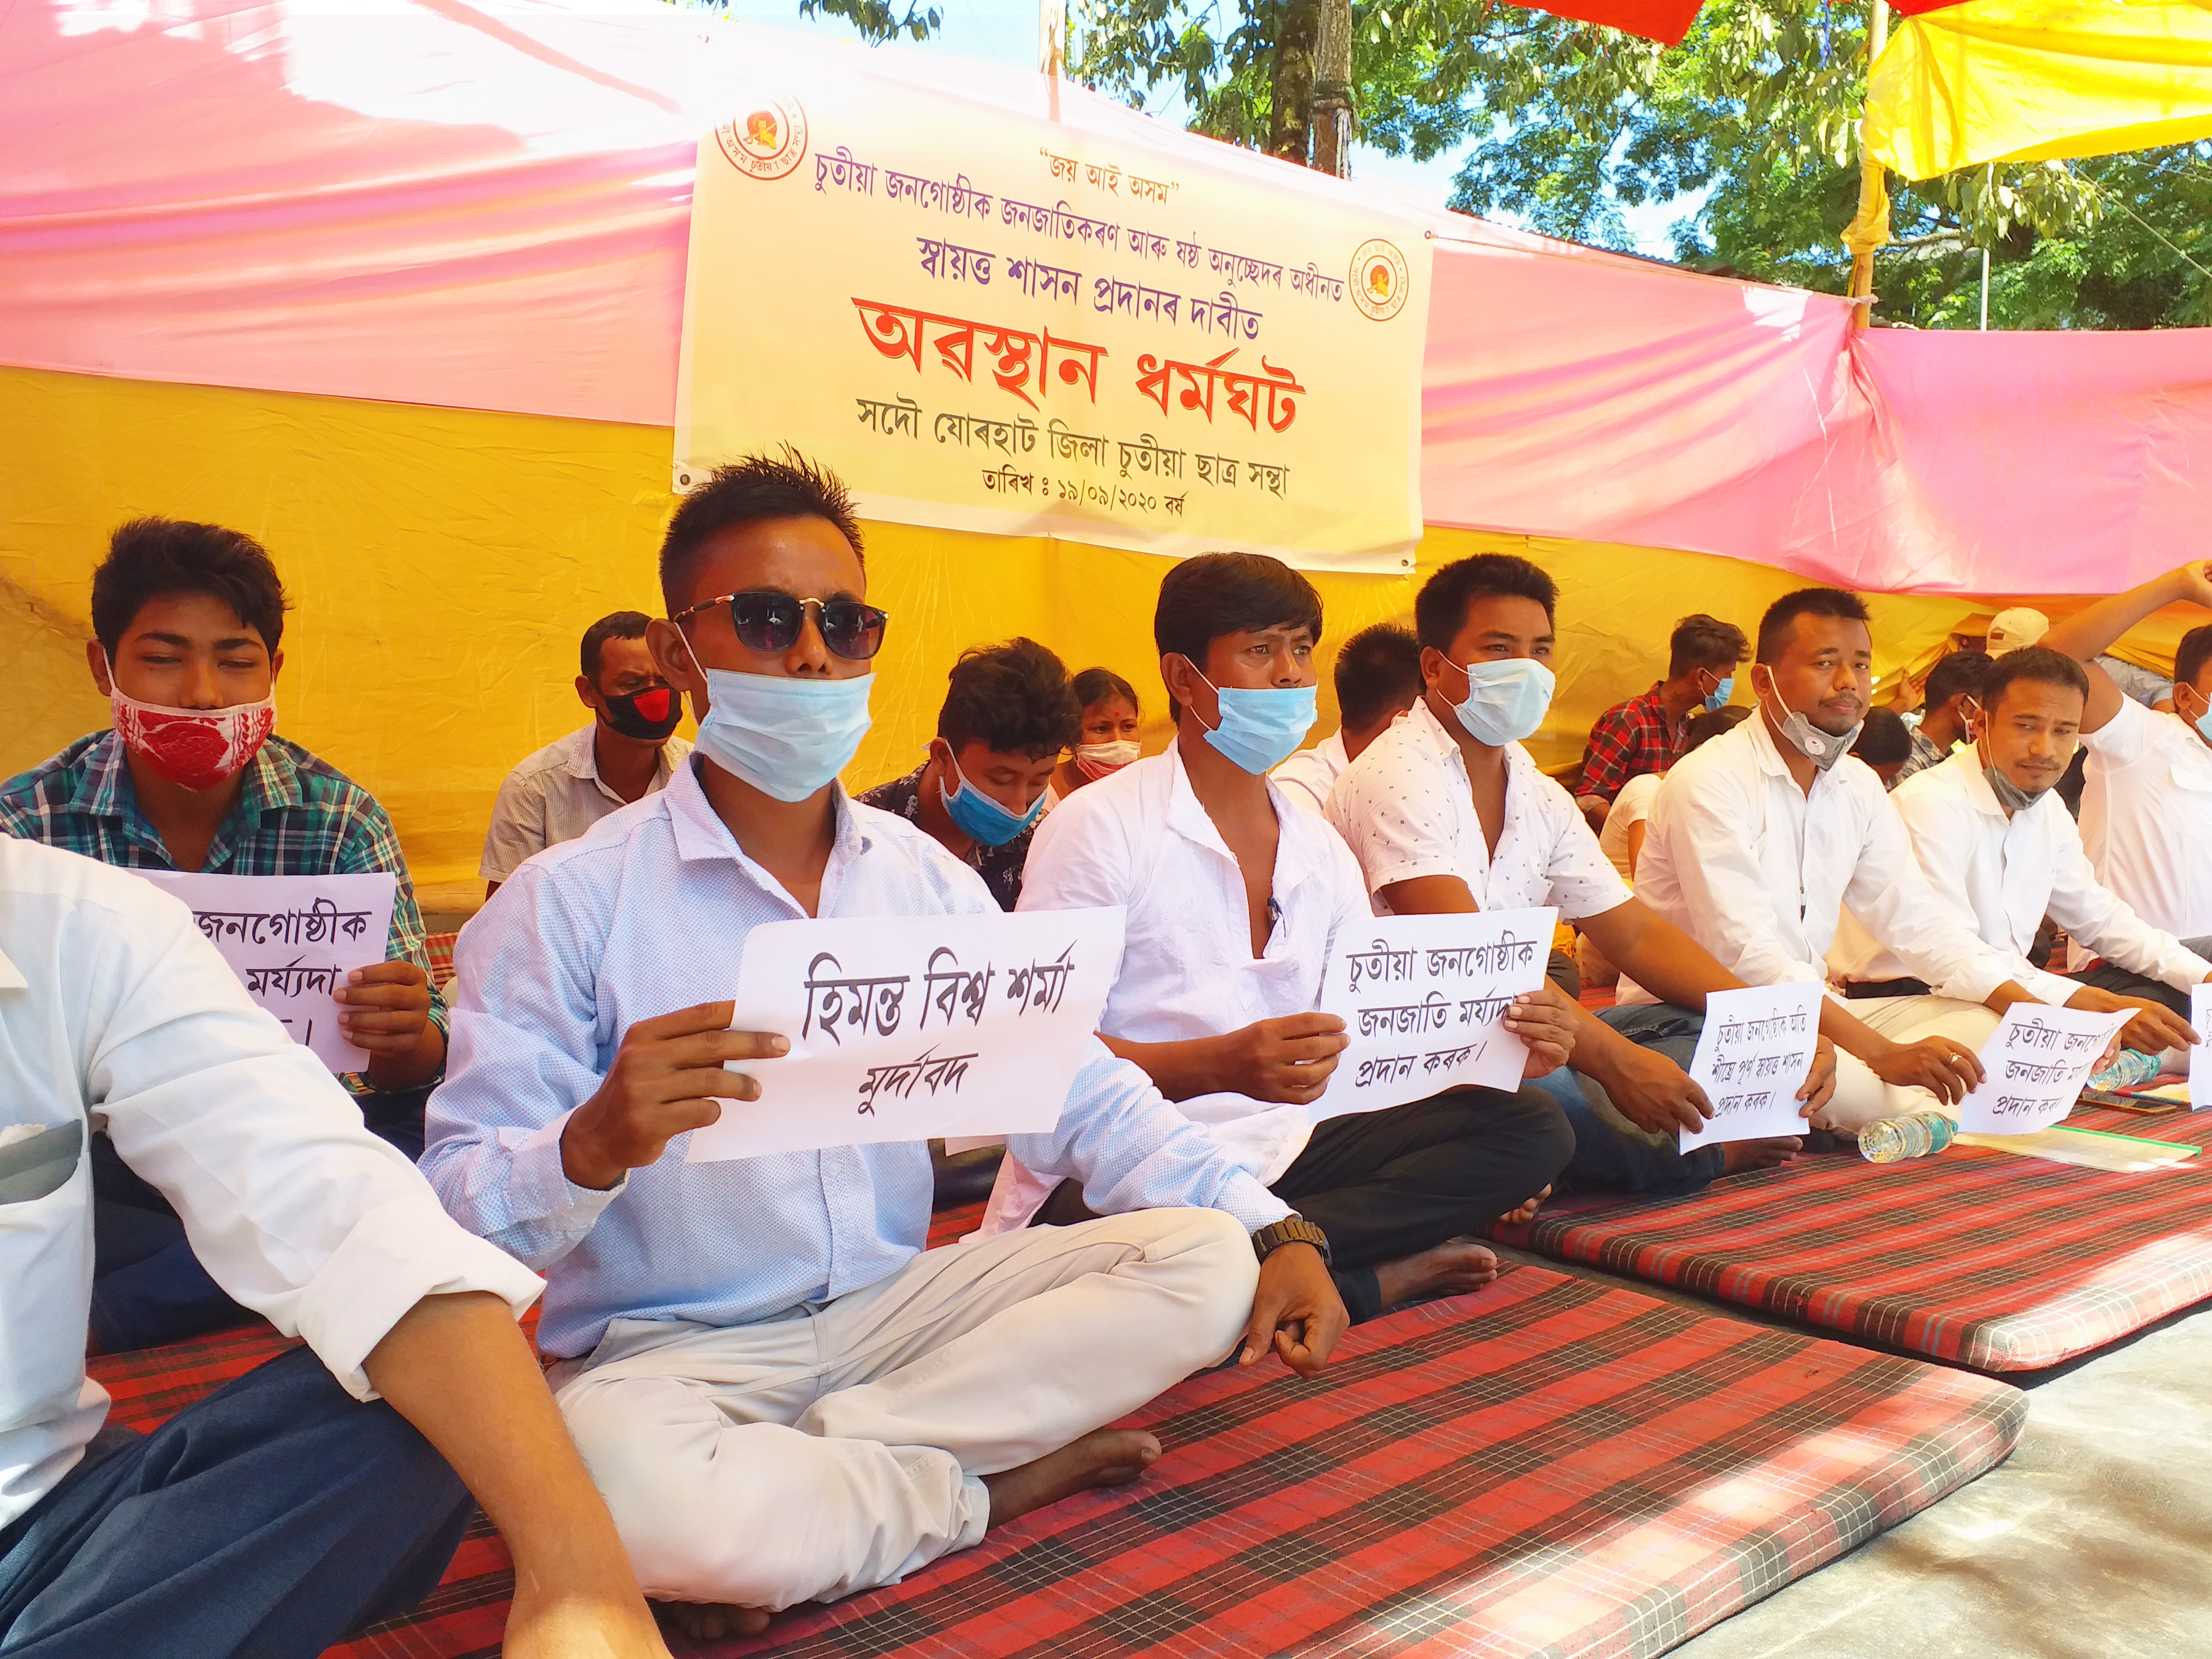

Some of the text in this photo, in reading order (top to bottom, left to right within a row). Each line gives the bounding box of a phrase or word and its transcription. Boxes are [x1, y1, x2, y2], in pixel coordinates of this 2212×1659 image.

[1040, 146, 1179, 205] “জয় আই অসম”
[815, 145, 1345, 303] চুতীয়া জনগোষ্ঠীক জনজাতিকৰণ আৰু ষষ্ঠ অনুচ্ছেদৰ অধীনত
[916, 236, 1263, 340] স্বায়ত্ত শাসন প্ৰদানৰ দাবীত
[851, 296, 1307, 433] অৱস্থান ধৰ্মঘট
[855, 391, 1291, 502] সদৌ যোৰহাট জিলা চুতীয়া ছাত্ৰ সন্থা
[981, 464, 1034, 496] তাৰিখ
[1058, 479, 1157, 512] ১৯/০৯/২০২০
[1164, 491, 1189, 518] বৰ্ষ
[192, 897, 373, 945] জনগোষ্ঠীক
[1346, 930, 1538, 994] চুতীয়া জনগোষ্ঠীক
[802, 939, 1078, 1045] হিমন্ত বিশ্ব শৰ্মা
[1357, 991, 1451, 1039] জনজাতি
[1714, 1004, 1807, 1053] চুতীয়া জনগোষ্ঠীক অতি
[2005, 1018, 2062, 1050] চুতীয়া
[858, 1043, 979, 1118] মুৰ্দাবদ
[1355, 1053, 1418, 1087] প্ৰদান
[1782, 1052, 1804, 1074] শাসন
[2005, 1059, 2068, 1086] জনজাতি
[1715, 1093, 1744, 1118] প্ৰদান
[1993, 1094, 2037, 1118] প্ৰদান
